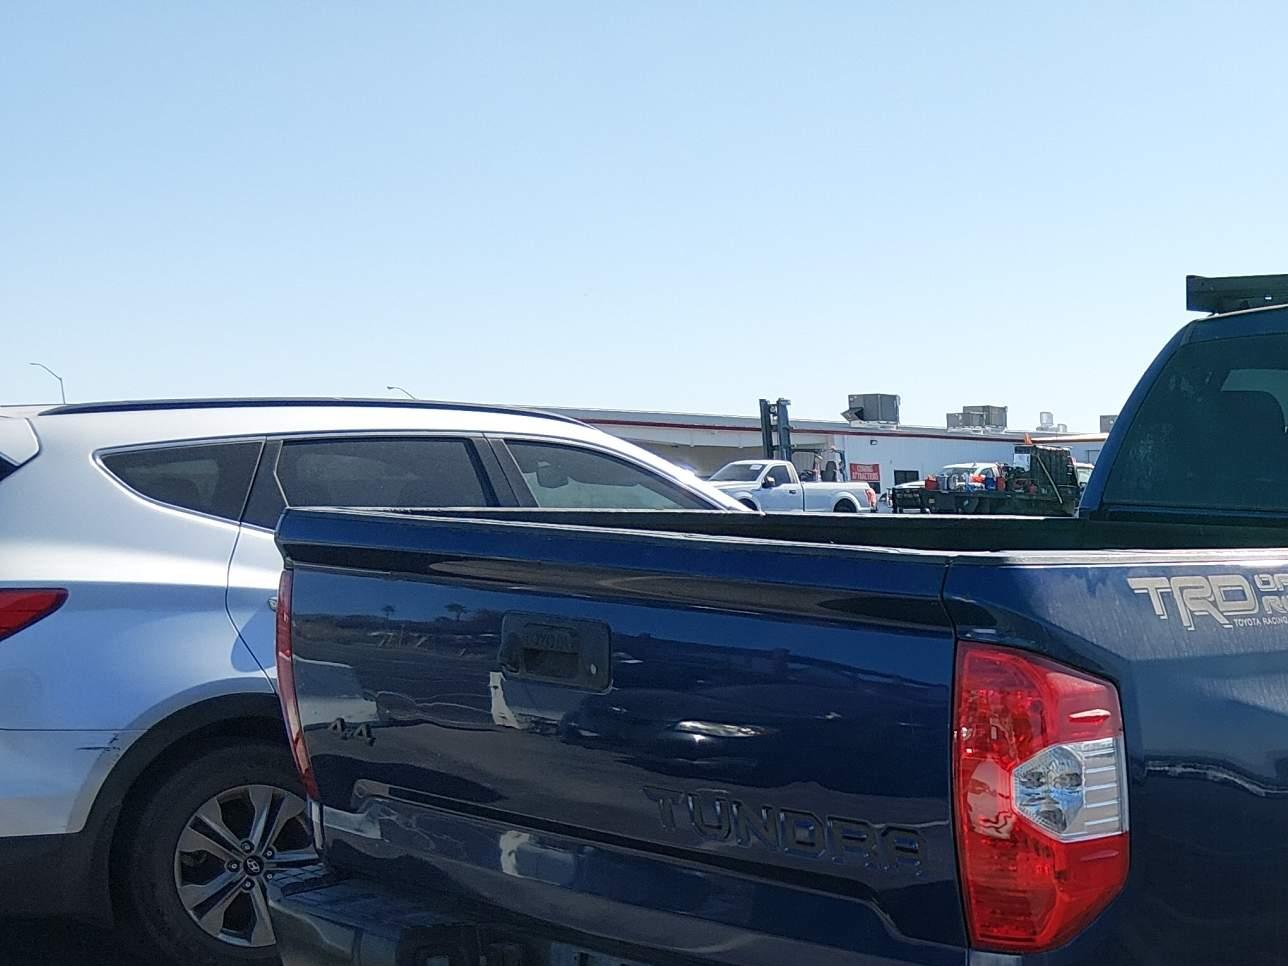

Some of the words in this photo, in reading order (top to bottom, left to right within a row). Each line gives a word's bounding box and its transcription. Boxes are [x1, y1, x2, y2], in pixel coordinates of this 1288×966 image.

[1127, 574, 1259, 631] TRD
[1233, 617, 1261, 628] TOYOTA
[1262, 615, 1288, 626] RACING
[641, 785, 926, 878] TUNDRA
